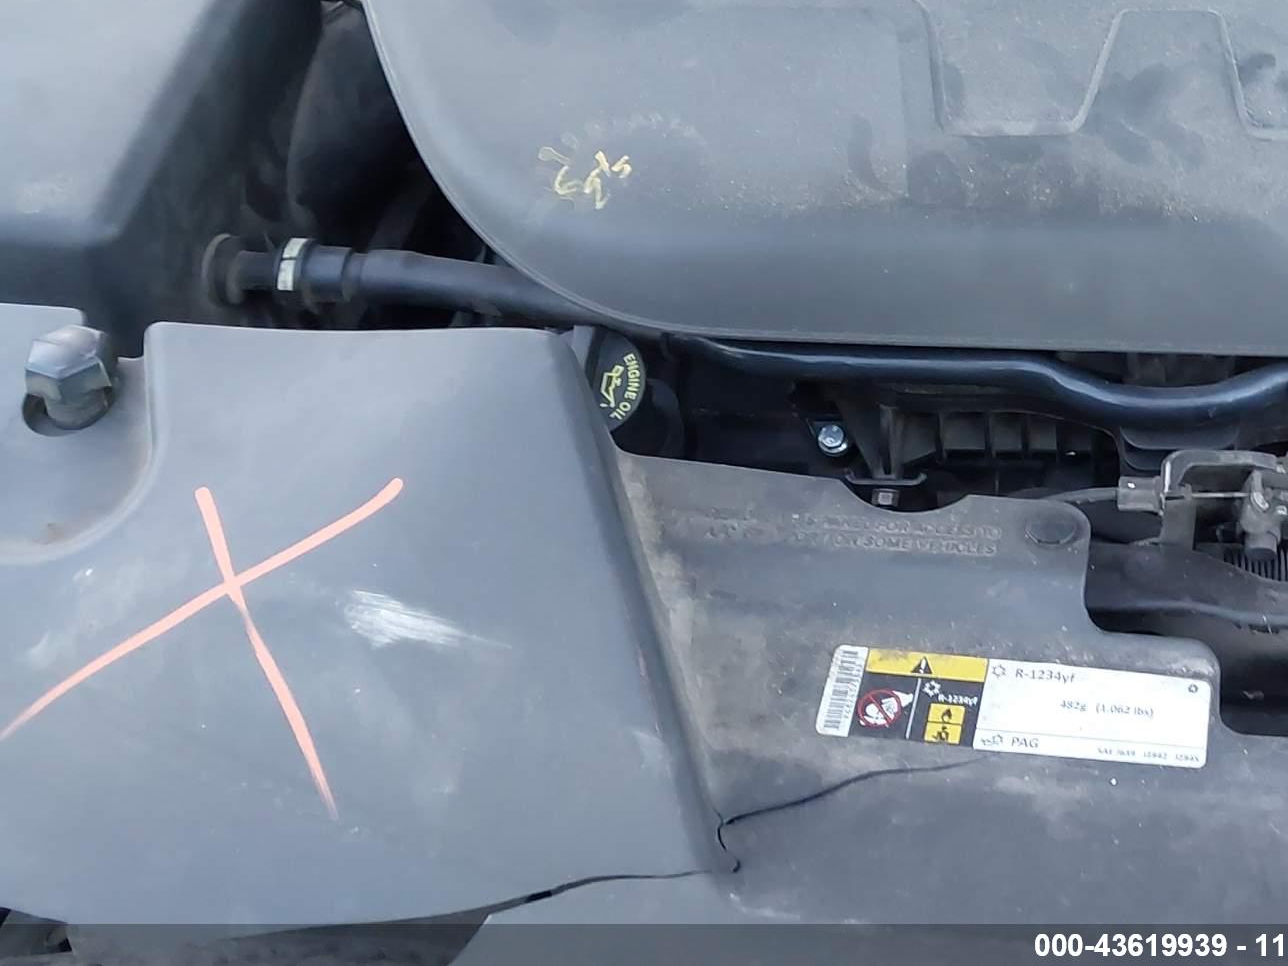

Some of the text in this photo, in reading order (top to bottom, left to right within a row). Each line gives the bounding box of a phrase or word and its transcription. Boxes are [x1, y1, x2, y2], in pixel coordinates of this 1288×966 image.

[609, 353, 641, 420] ENGINE OIL
[1014, 668, 1076, 684] R-1234yf
[1011, 736, 1040, 749] PAG
